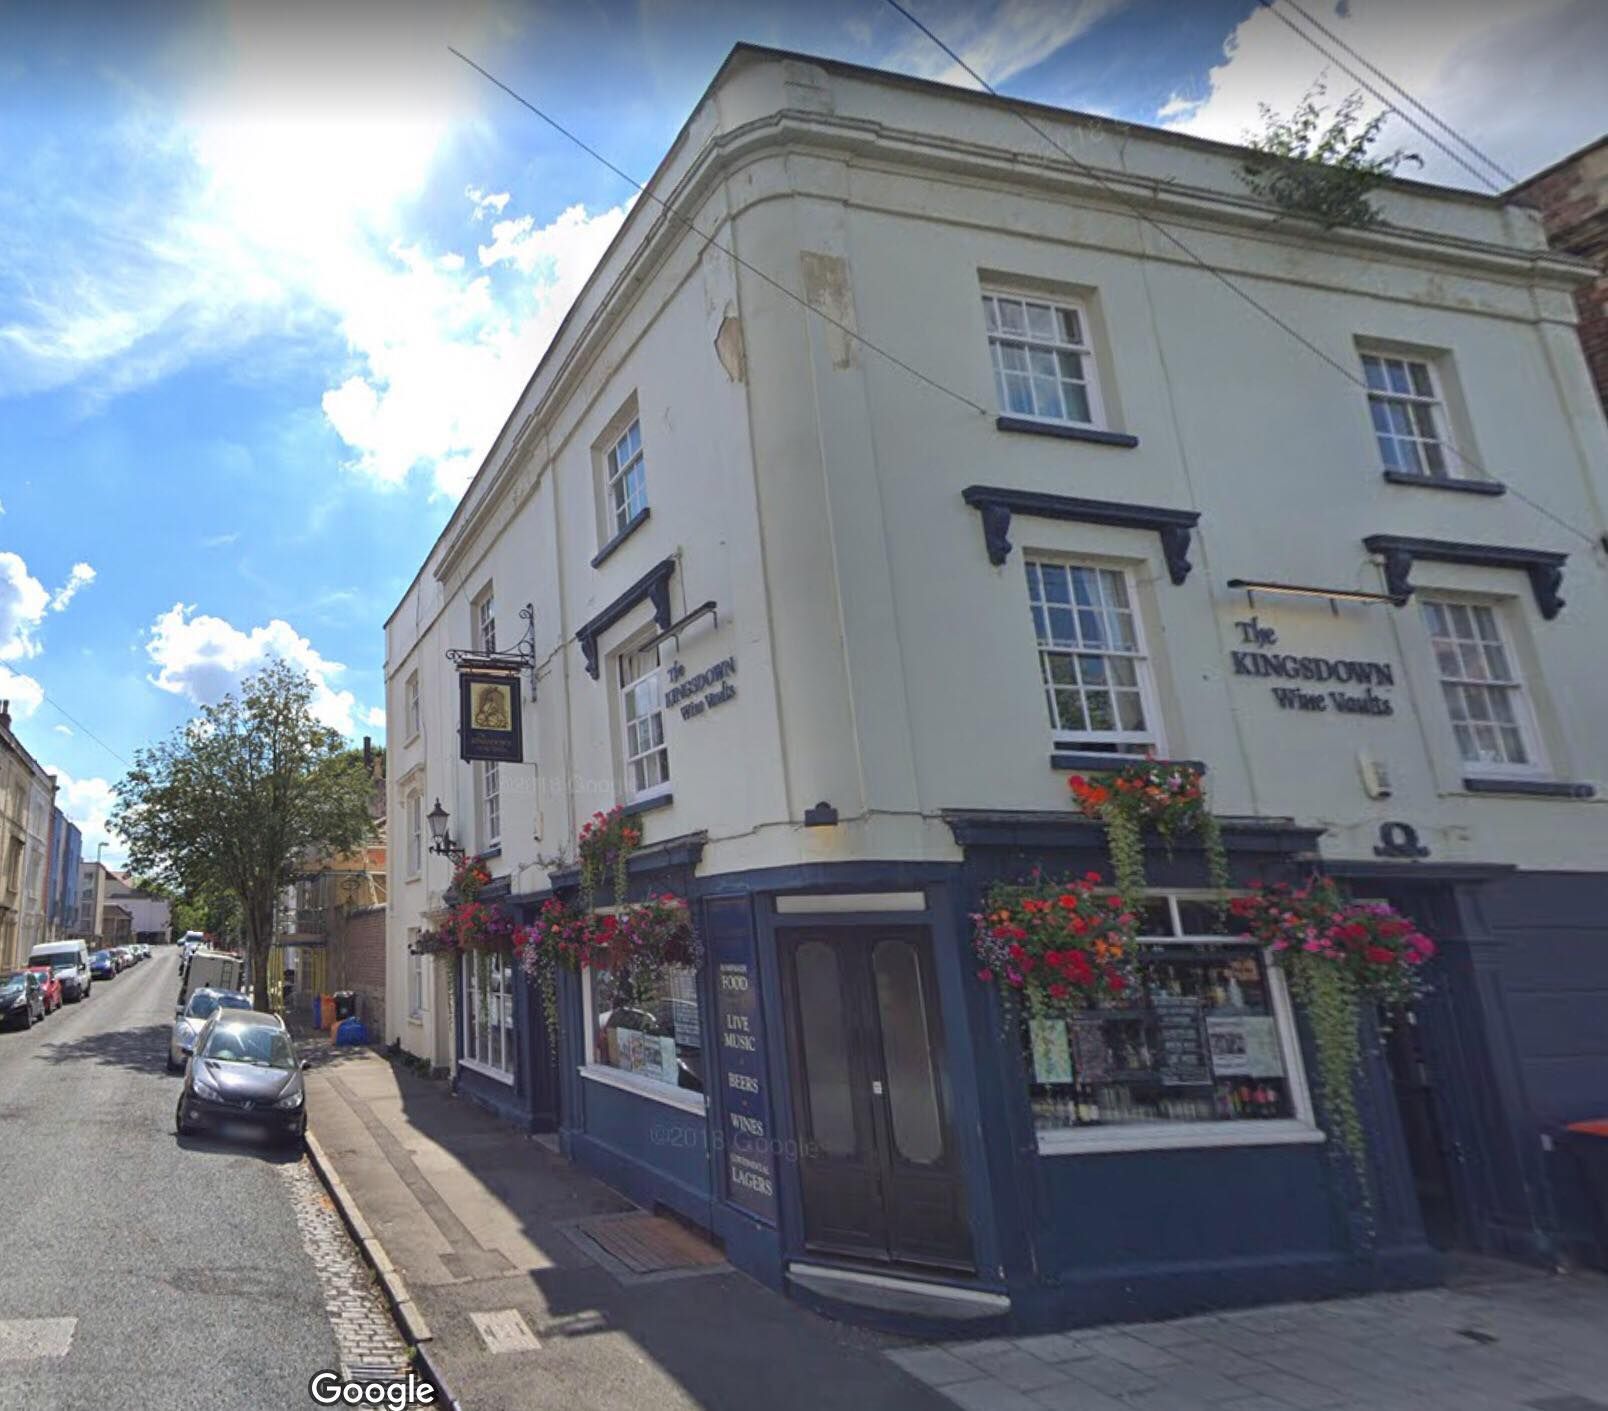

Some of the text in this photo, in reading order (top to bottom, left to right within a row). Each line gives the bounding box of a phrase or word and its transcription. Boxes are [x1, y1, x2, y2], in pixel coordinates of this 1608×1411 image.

[1235, 616, 1278, 648] The
[667, 660, 686, 683] The
[1231, 651, 1394, 686] KINGSDOWN
[1271, 687, 1394, 716] Wine Vaults
[721, 975, 749, 991] FOOD
[726, 1014, 750, 1032] LIVE
[723, 1032, 756, 1052] MUSIC
[728, 1071, 759, 1094] BEERS
[730, 1112, 764, 1137] WINES
[731, 1166, 773, 1197] LAGERS
